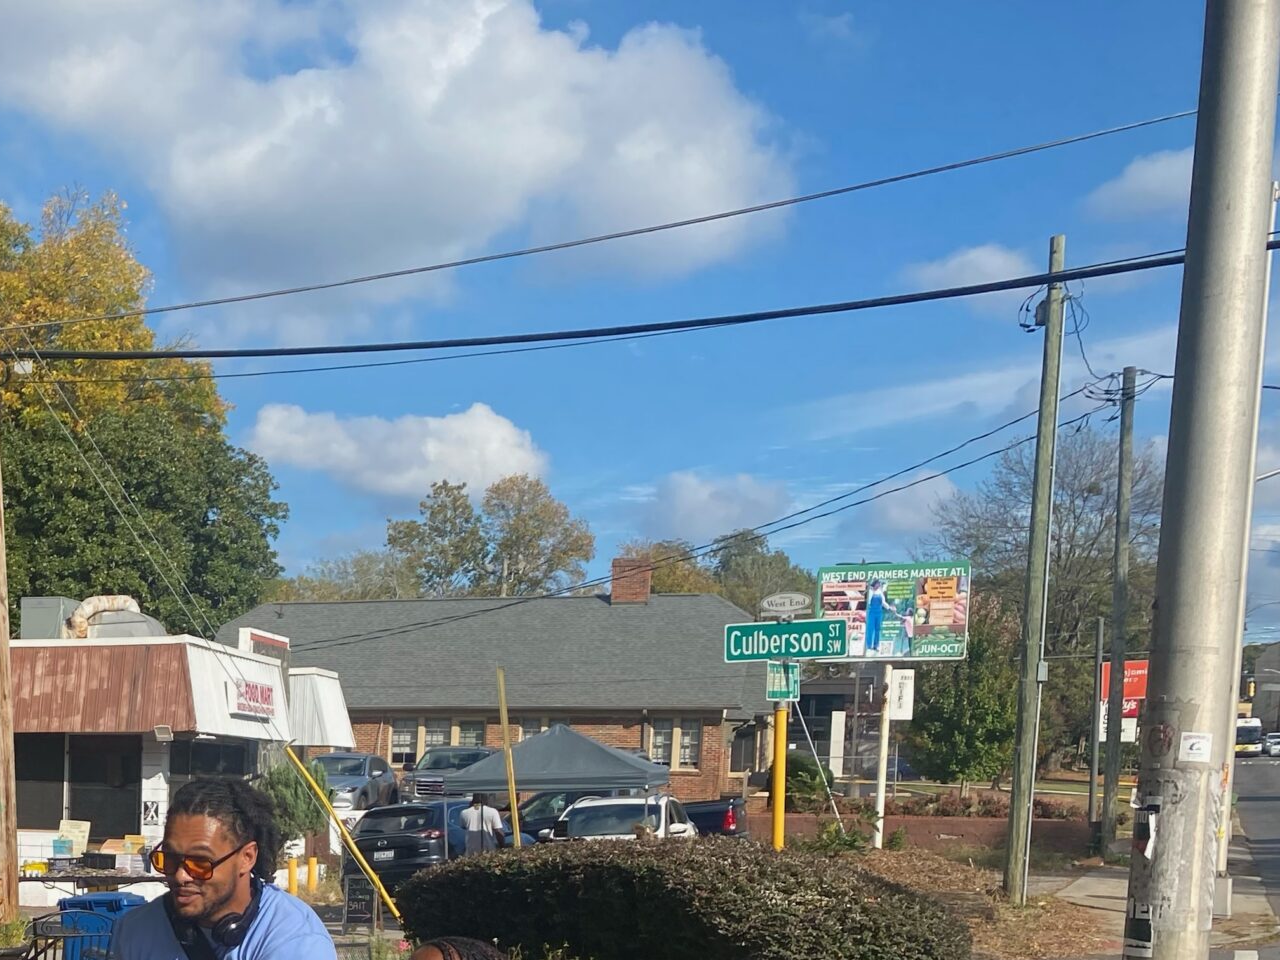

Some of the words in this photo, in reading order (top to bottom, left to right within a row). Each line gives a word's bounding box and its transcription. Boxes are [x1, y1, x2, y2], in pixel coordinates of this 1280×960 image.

[822, 572, 846, 582] WEST
[847, 571, 866, 580] END
[868, 569, 909, 580] FARMERS
[910, 568, 948, 579] MARKET
[950, 567, 967, 577] ATL
[767, 599, 786, 608] West
[789, 598, 806, 606] End
[828, 623, 841, 638] ST
[730, 629, 823, 656] Culberson
[826, 640, 842, 654] SW
[918, 643, 959, 654] JUN-OCT
[245, 683, 259, 703] FOOD
[260, 686, 274, 706] MART
